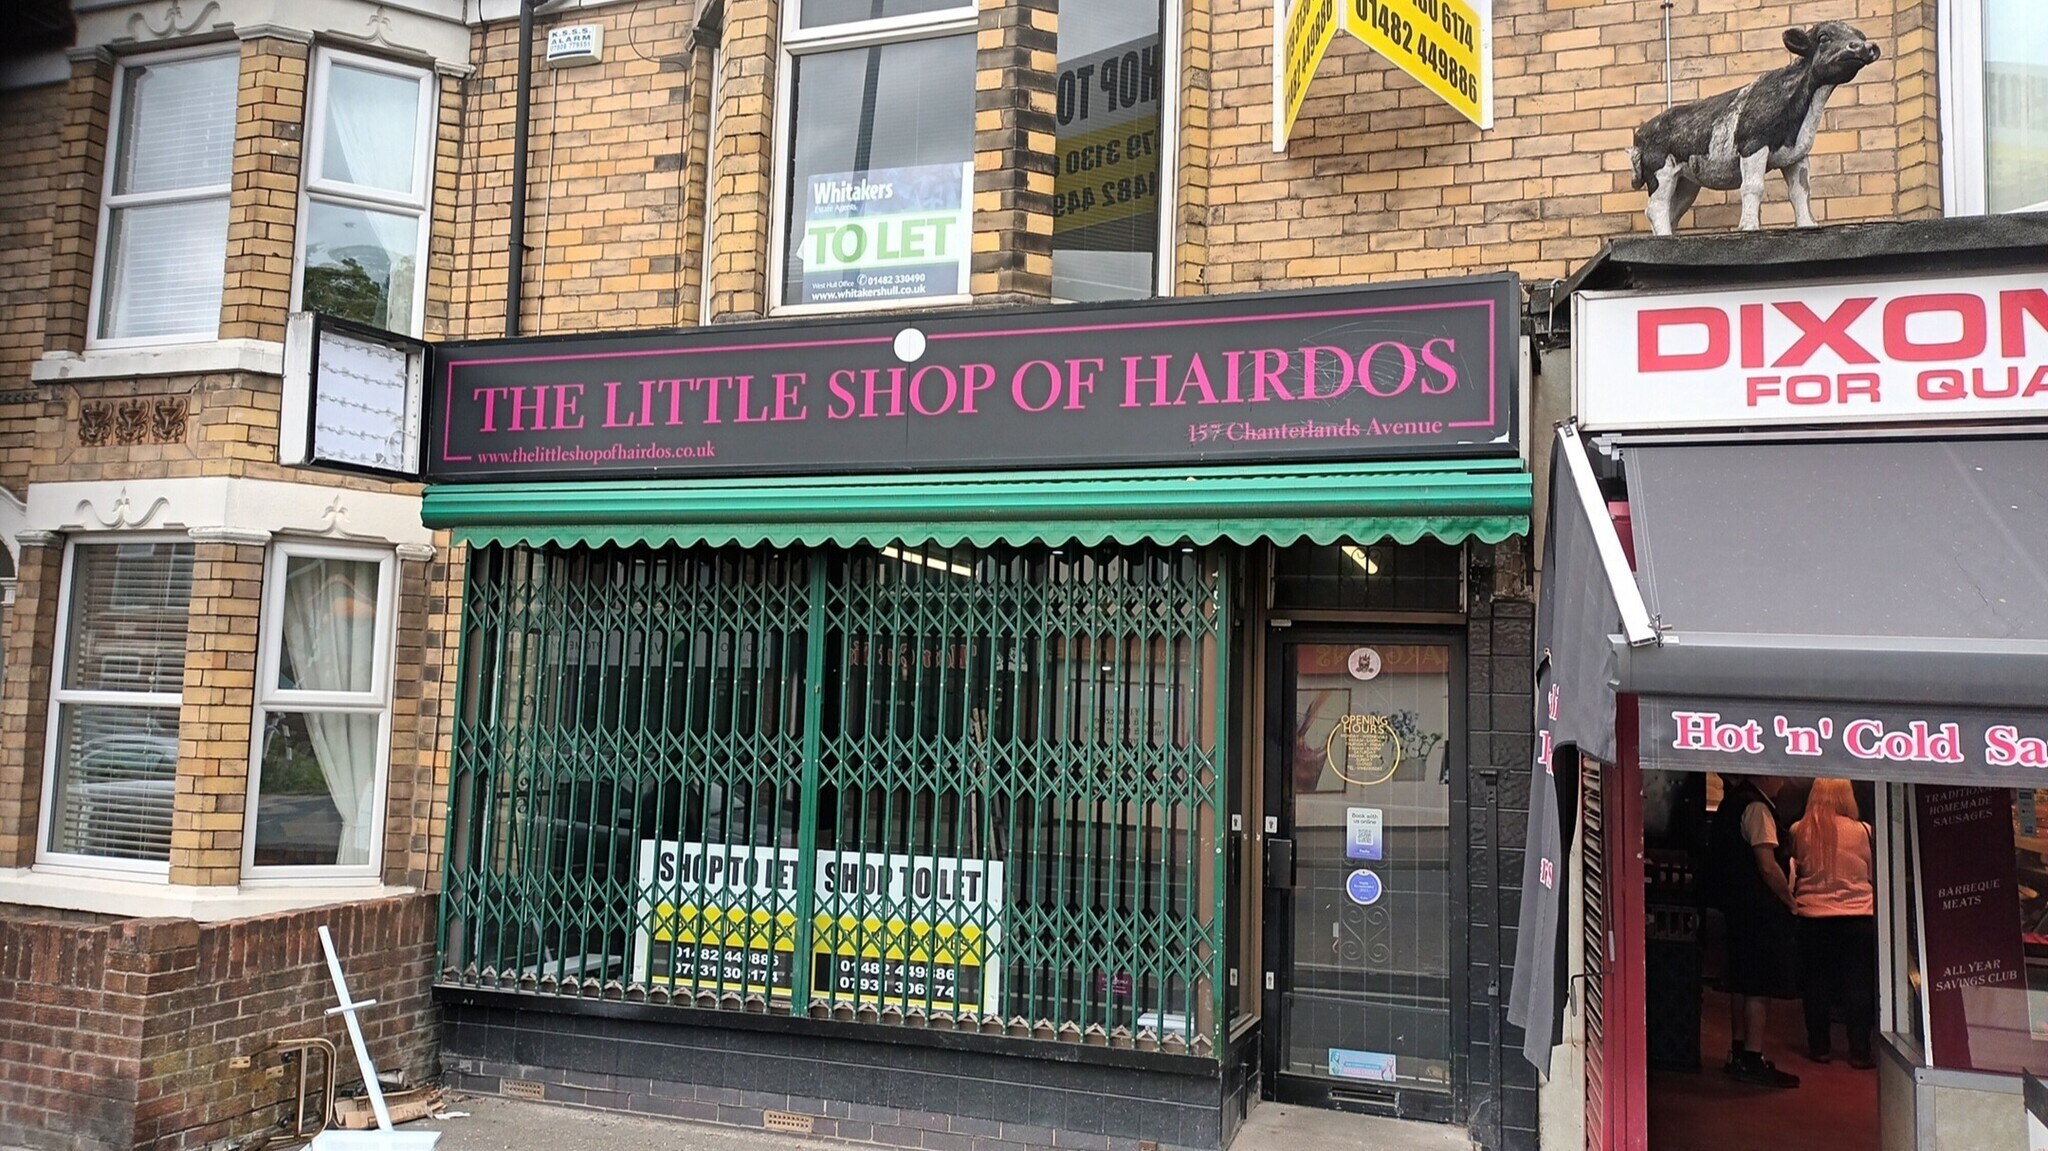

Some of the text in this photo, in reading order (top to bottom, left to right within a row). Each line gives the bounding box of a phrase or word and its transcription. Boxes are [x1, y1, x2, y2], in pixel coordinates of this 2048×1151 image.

[1442, 1, 1473, 53] 6174
[552, 34, 591, 45] ALARM
[1356, 0, 1478, 105] 01482 449886
[814, 178, 893, 204] Whitakers
[808, 216, 957, 265] TO LET
[867, 276, 893, 286] 01482
[895, 273, 926, 284] 330490
[811, 284, 926, 300] www.whitakershull.co.uk
[474, 338, 1458, 432] THE LITTLE SHOP OF HAIRDOS
[1746, 373, 1881, 406] FOR
[1188, 417, 1444, 443] 157 Chanterlands Avenue
[477, 440, 716, 467] www.thelittleshopofhairdos.co.uk
[1341, 715, 1388, 725] OPENING
[1343, 723, 1384, 734] HOURS
[1673, 712, 2048, 767] Hot 'n' Cold Sa
[1929, 796, 1992, 816] HOMEMADE
[1933, 808, 1993, 828] SAUSAGES
[660, 852, 723, 884] SHOP
[730, 857, 759, 892] TO
[824, 861, 981, 903] SHOP TO LET
[1938, 879, 2001, 898] BARBEQUE
[1942, 895, 1982, 910] MEATS
[1943, 959, 2001, 977] ALL YEAR
[1936, 970, 2017, 991] SAVINGS CLUB
